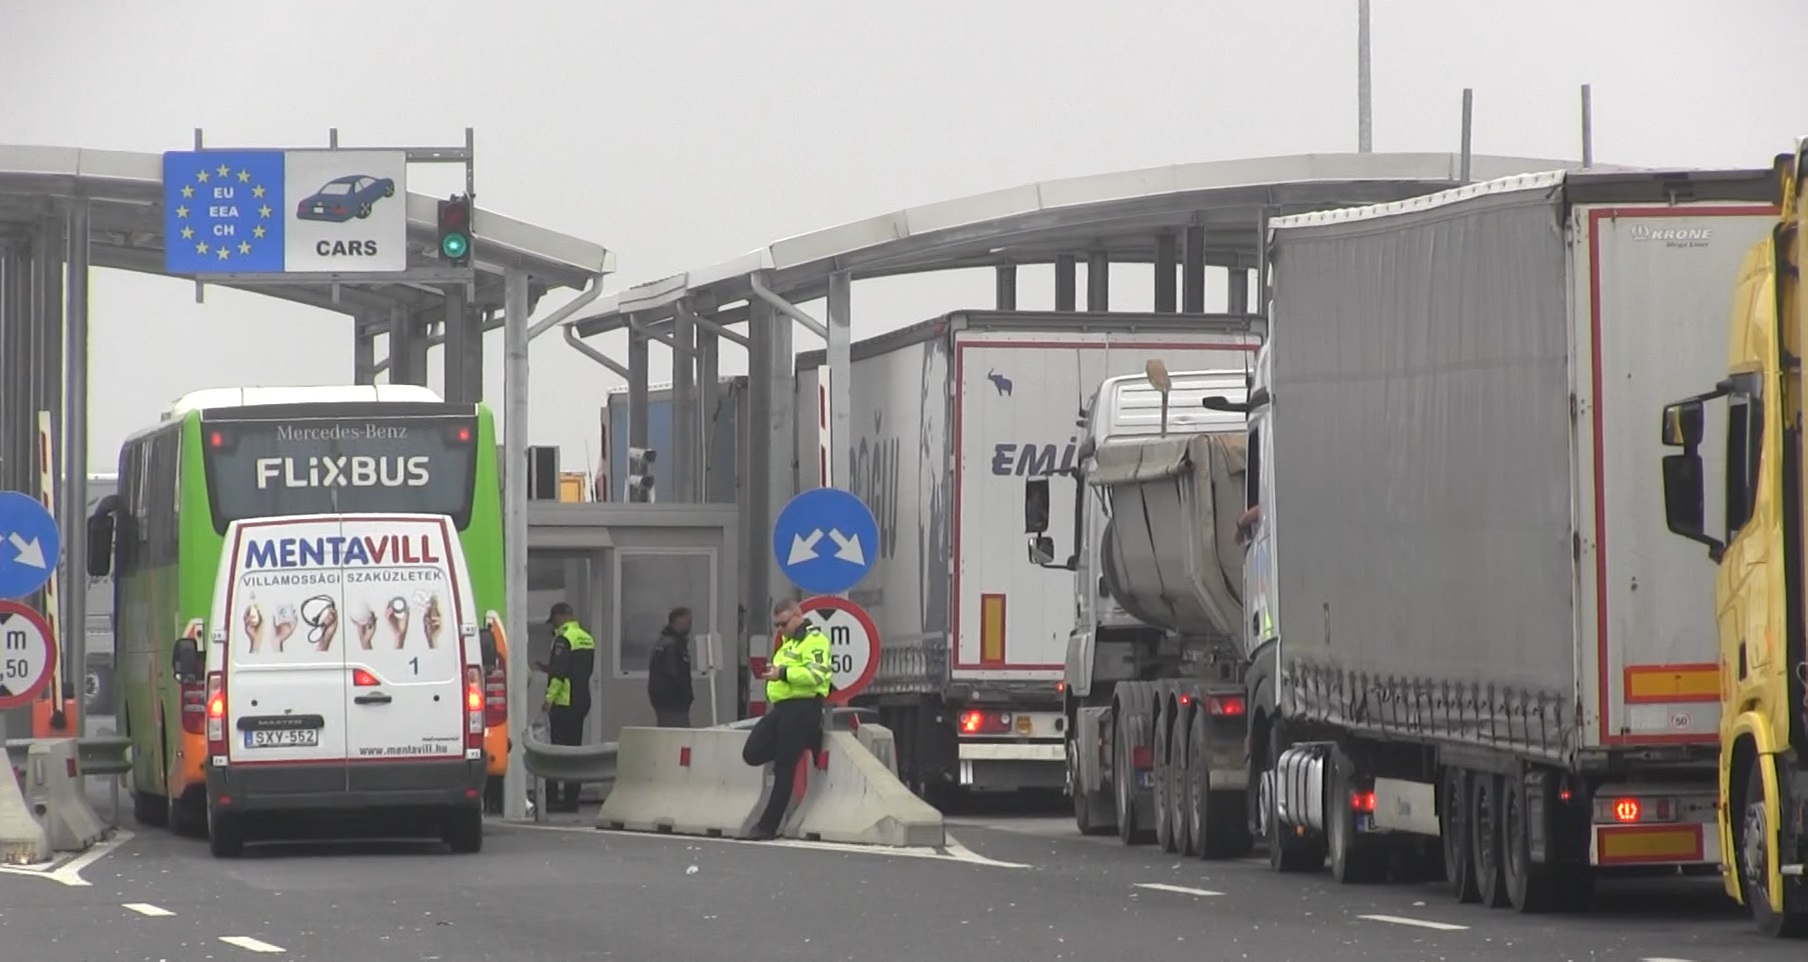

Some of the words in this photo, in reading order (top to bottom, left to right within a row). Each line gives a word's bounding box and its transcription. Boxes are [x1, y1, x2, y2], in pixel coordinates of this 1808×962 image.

[213, 187, 234, 199] EU
[209, 205, 239, 218] EEA
[213, 225, 235, 237] CH
[1652, 229, 1712, 240] KRONE
[316, 240, 378, 256] CARS
[276, 424, 408, 441] Mercedes-Benz
[992, 436, 1078, 477] EMİ
[245, 534, 440, 569] MENTAVILL
[243, 572, 341, 587] VILLAMOSSÁGI
[347, 569, 442, 583] SZAKÜZLETEK
[6, 631, 26, 650] m
[830, 626, 850, 645] m
[0, 659, 28, 680] ,50
[409, 656, 419, 676] 1
[831, 655, 852, 673] 50
[255, 730, 315, 745] SXY-552
[359, 743, 448, 756] www.mentavill.hu
